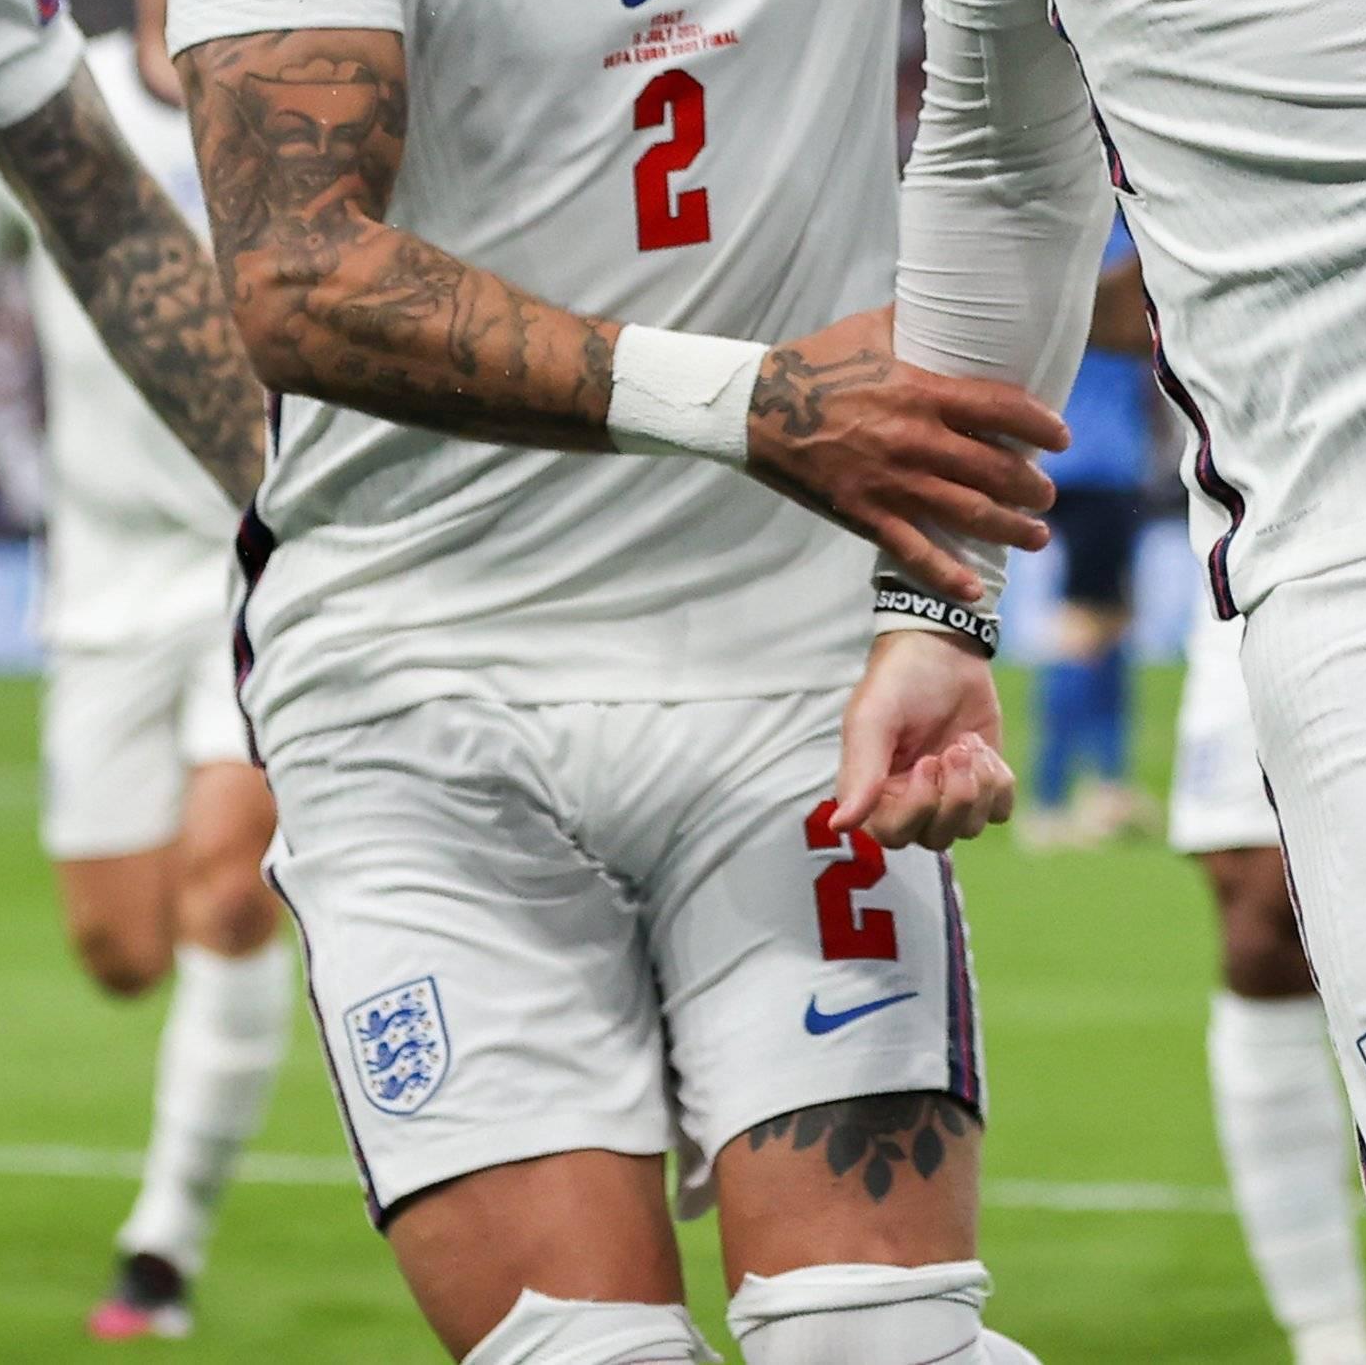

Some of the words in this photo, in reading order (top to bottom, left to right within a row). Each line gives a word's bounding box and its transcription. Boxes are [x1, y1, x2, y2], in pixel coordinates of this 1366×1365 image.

[634, 45, 667, 63] EURO
[702, 30, 740, 49] FINAL
[644, 25, 673, 44] JULY
[633, 68, 711, 252] 2
[948, 610, 978, 636] TO
[804, 798, 898, 962] 2
